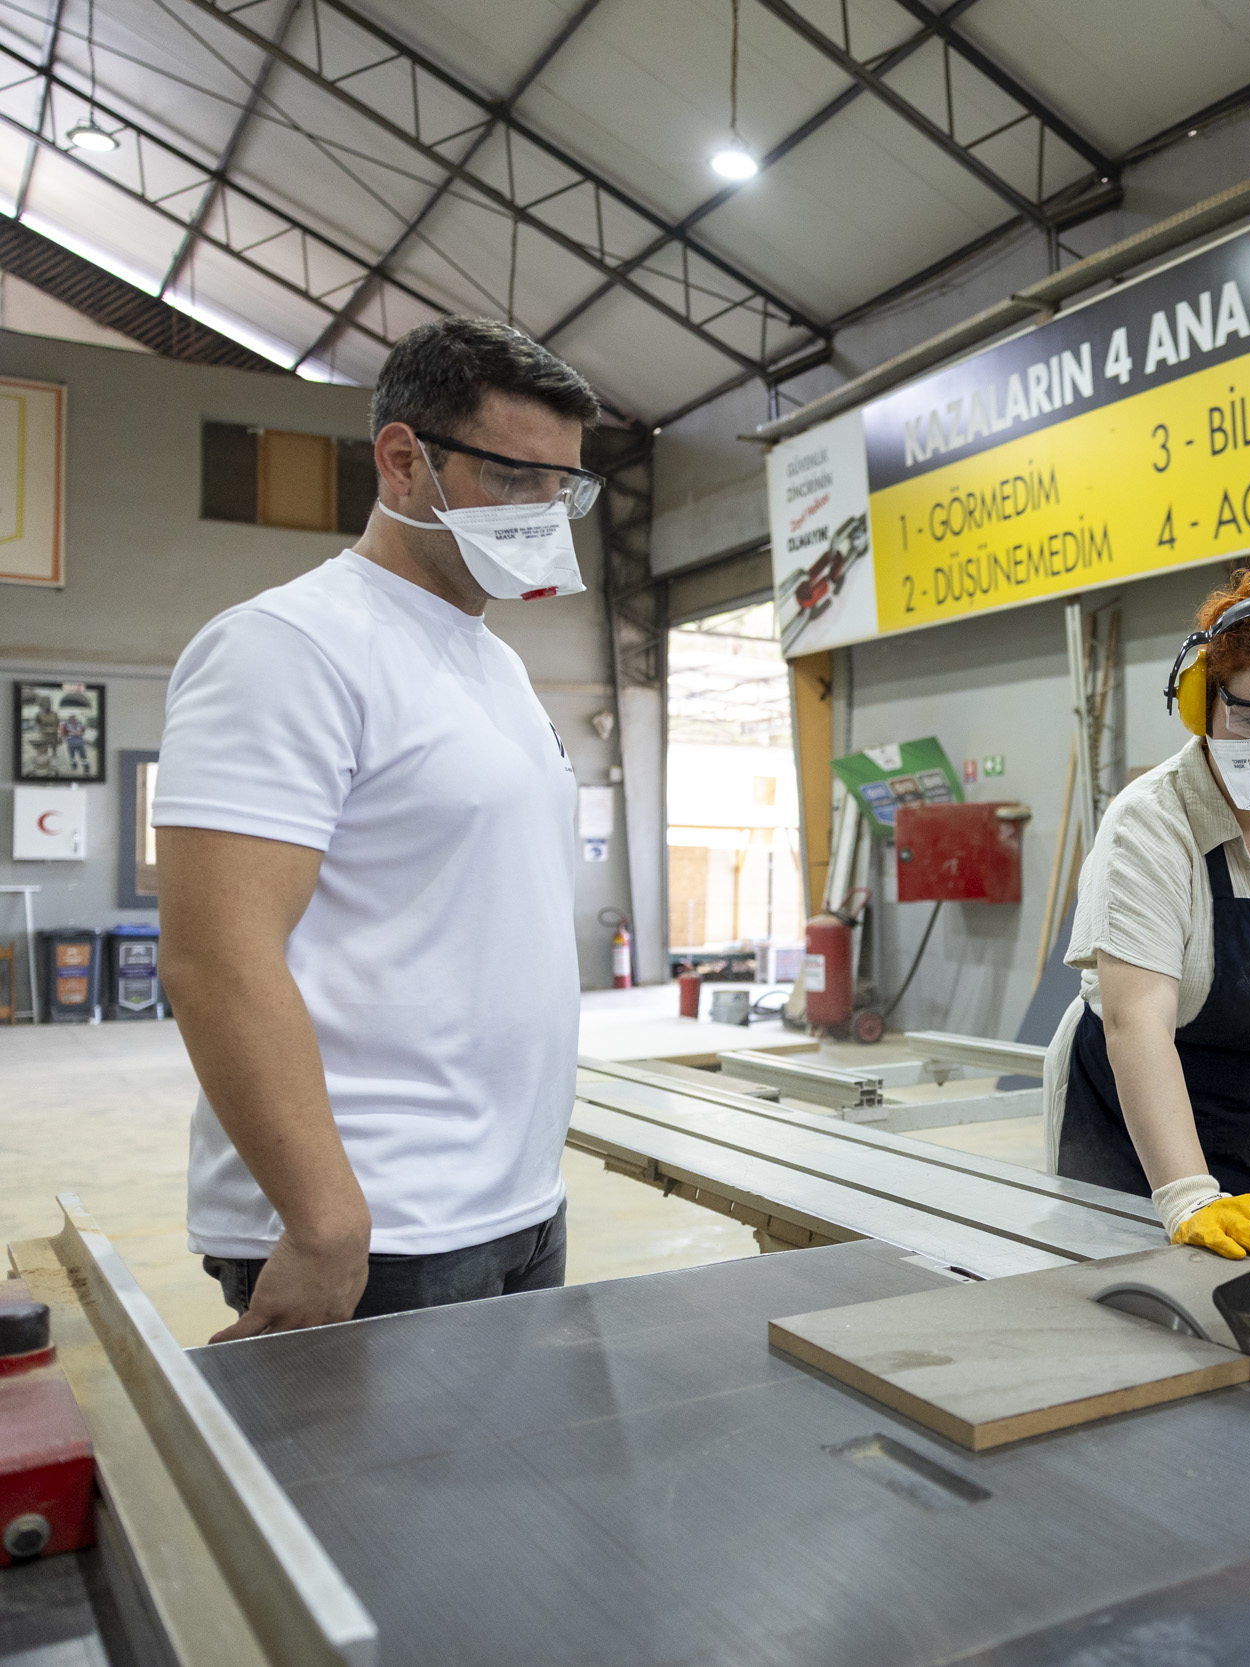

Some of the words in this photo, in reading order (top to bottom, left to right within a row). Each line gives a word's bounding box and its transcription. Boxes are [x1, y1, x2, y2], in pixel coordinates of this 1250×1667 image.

[904, 342, 1095, 467] KAZALARIN
[1104, 326, 1132, 385] 4
[1151, 423, 1171, 473] 3
[899, 514, 909, 551] 1
[929, 459, 1060, 542] GÖRMEDİM
[1157, 504, 1177, 550] 4
[902, 575, 916, 614] 2
[933, 514, 1114, 607] DÜŞÜNEMEDİM
